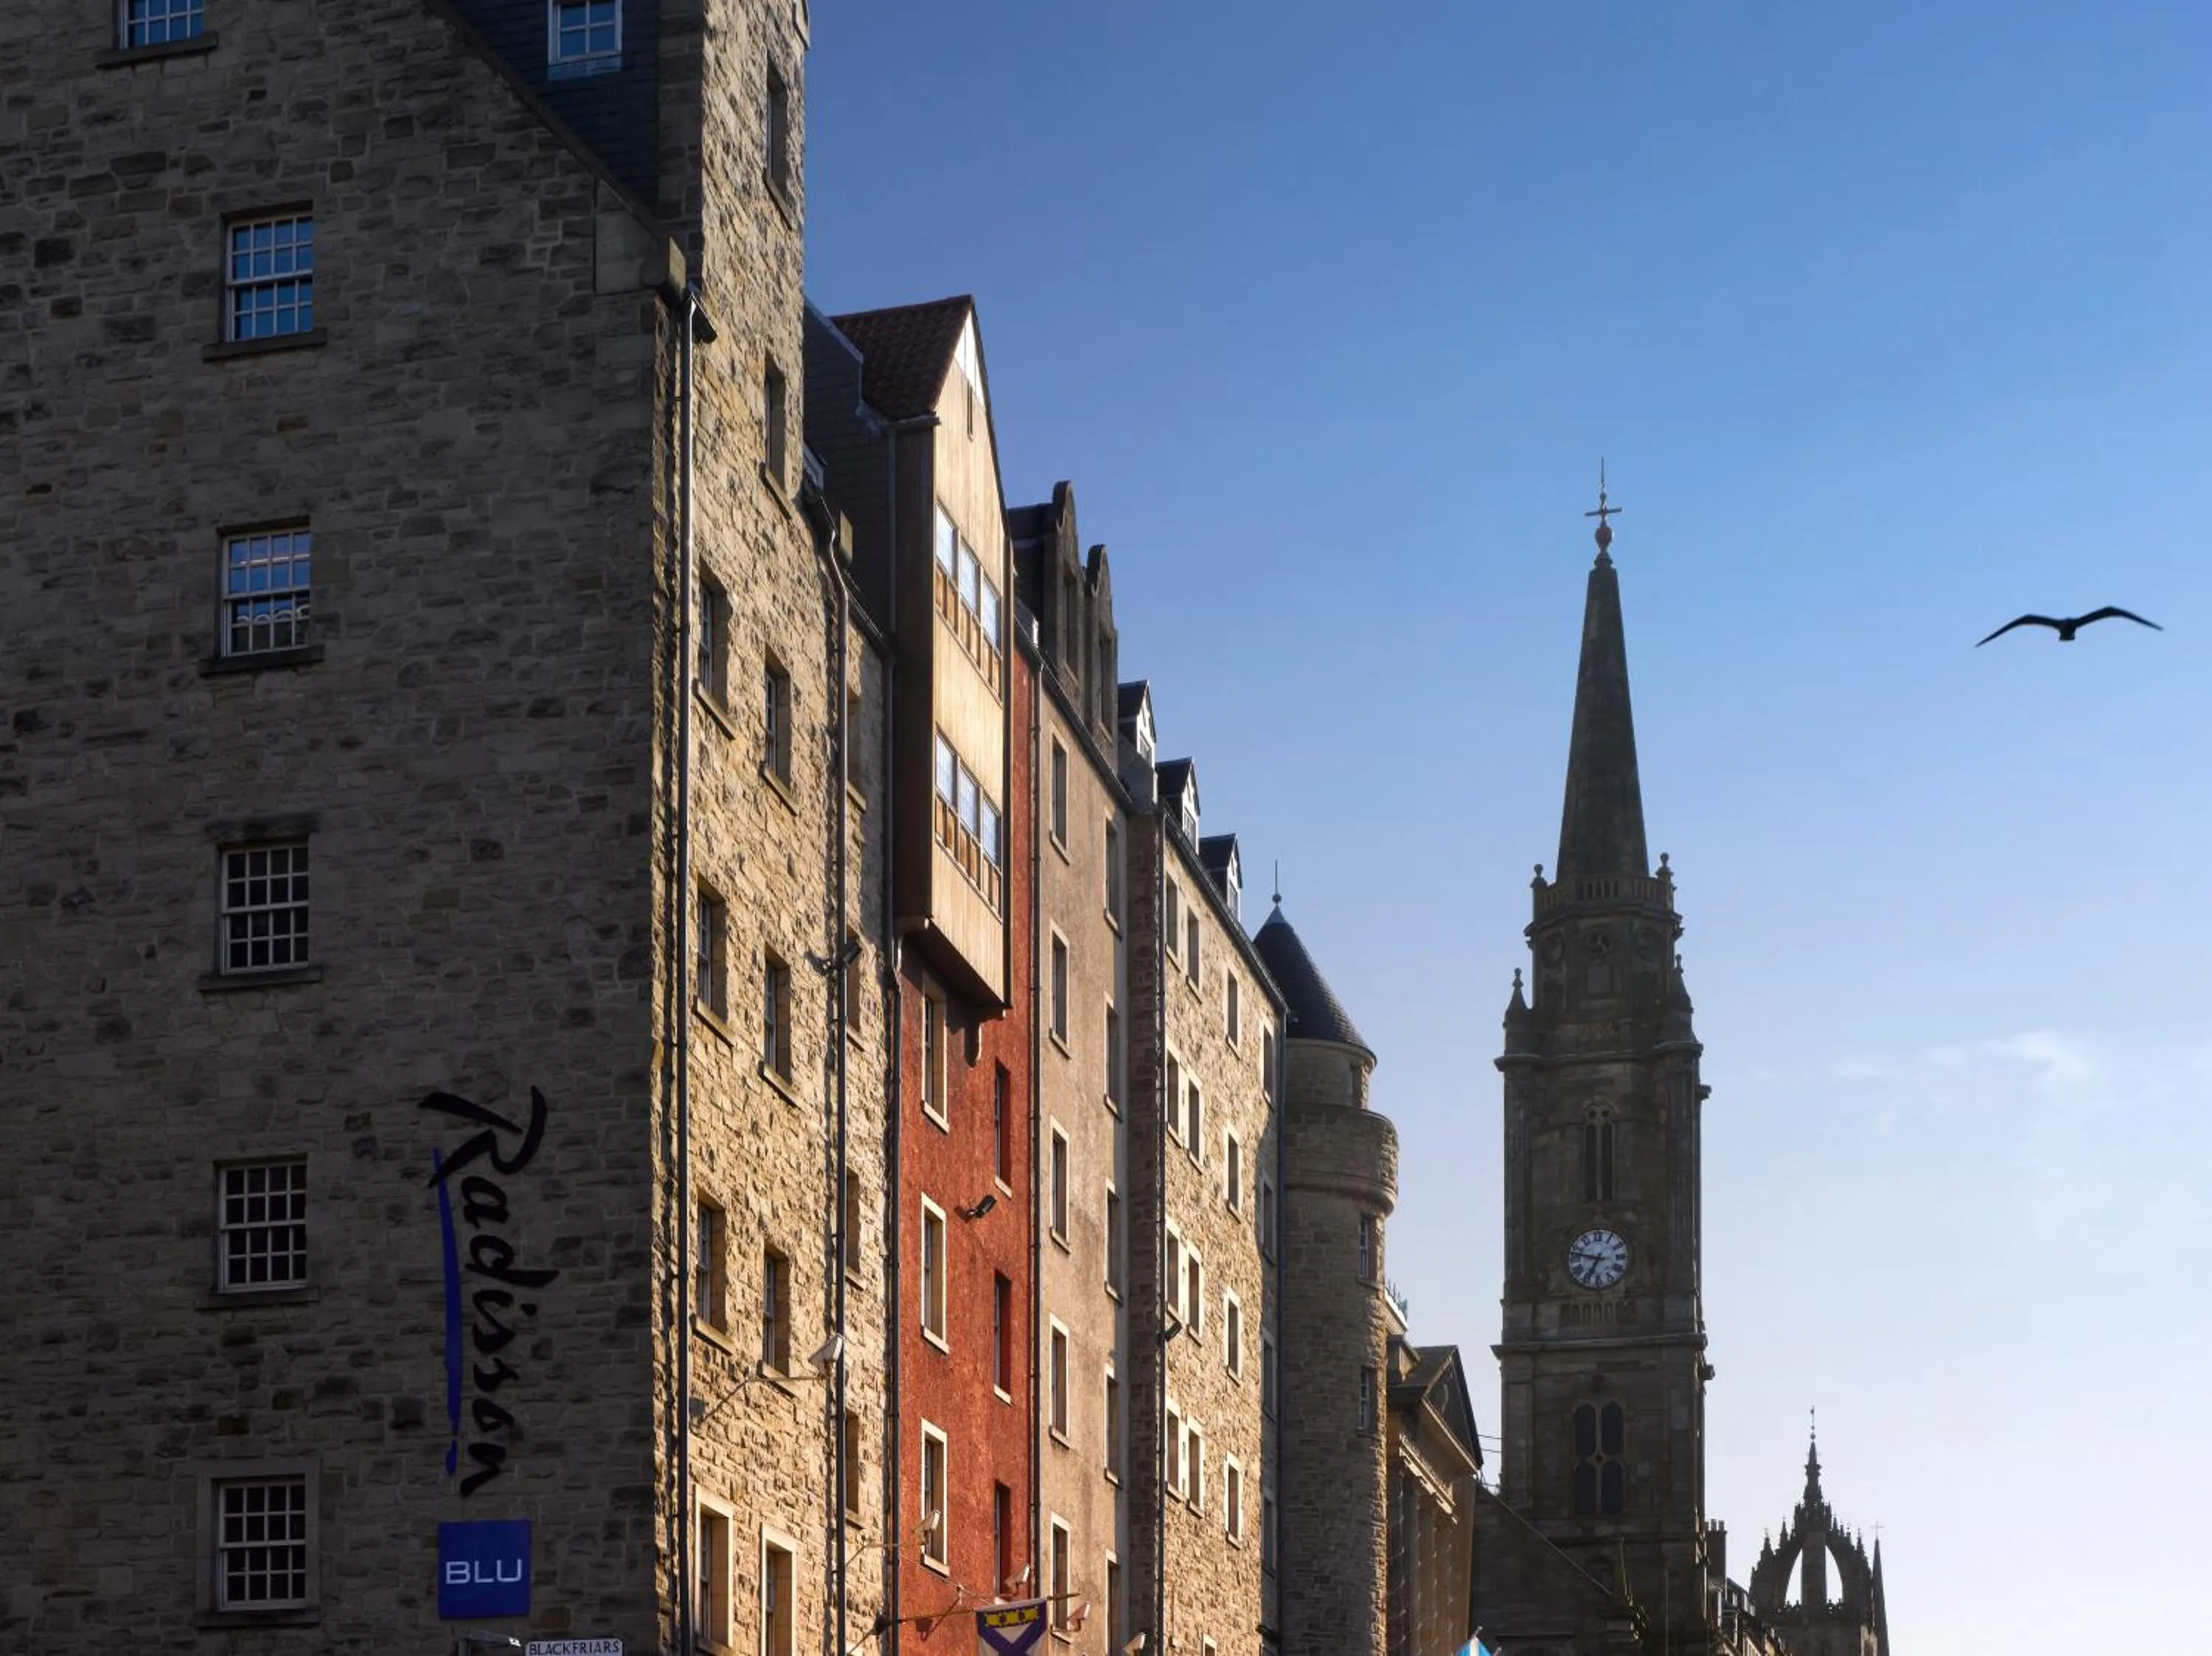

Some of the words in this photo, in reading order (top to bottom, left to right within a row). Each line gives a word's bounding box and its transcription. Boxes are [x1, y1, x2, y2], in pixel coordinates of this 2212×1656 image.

[418, 1085, 559, 1497] Radisson
[445, 1558, 523, 1584] BLU
[529, 1641, 620, 1655] BLACKFRIARS
